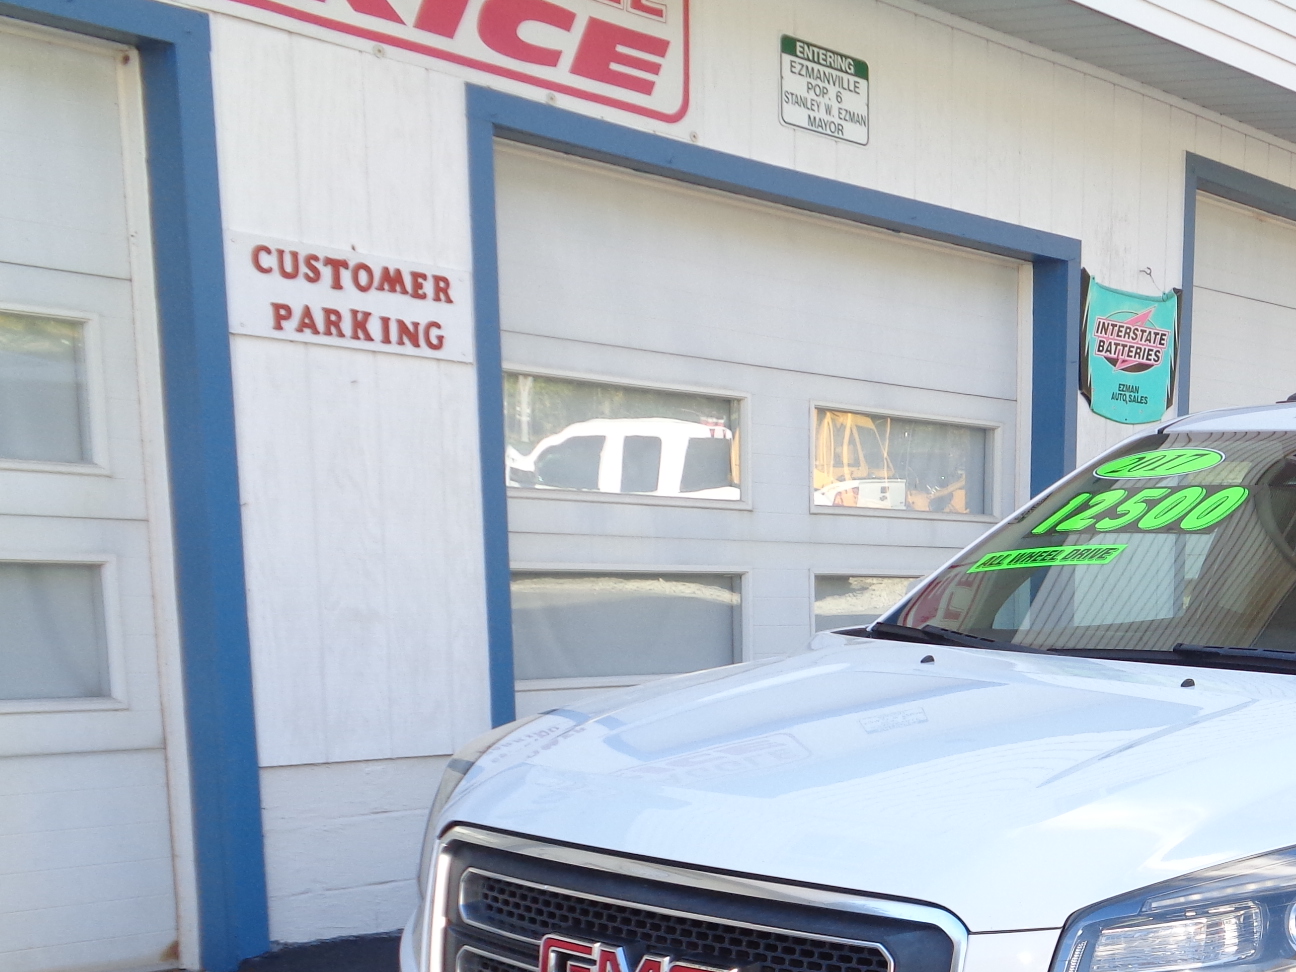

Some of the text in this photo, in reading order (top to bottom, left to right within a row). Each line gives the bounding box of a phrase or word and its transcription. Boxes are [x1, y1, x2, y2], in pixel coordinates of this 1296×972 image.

[795, 41, 855, 74] ENTERING
[789, 60, 861, 95] EZMANVILLE
[806, 81, 843, 104] POP. 6
[783, 90, 867, 128] STANLEY W. EZMAN
[807, 114, 844, 136] MAYOR
[251, 244, 454, 304] CUSTOMER
[271, 302, 445, 350] PARKING
[1095, 320, 1168, 347] INTERSTATE
[1097, 339, 1162, 363] BATTERIES
[1118, 383, 1140, 394] EZMAN
[1128, 394, 1149, 405] SALES
[1104, 453, 1211, 474] 2017
[1031, 486, 1250, 535] 12500
[974, 547, 1119, 570] ALL WHEEL DRIVE
